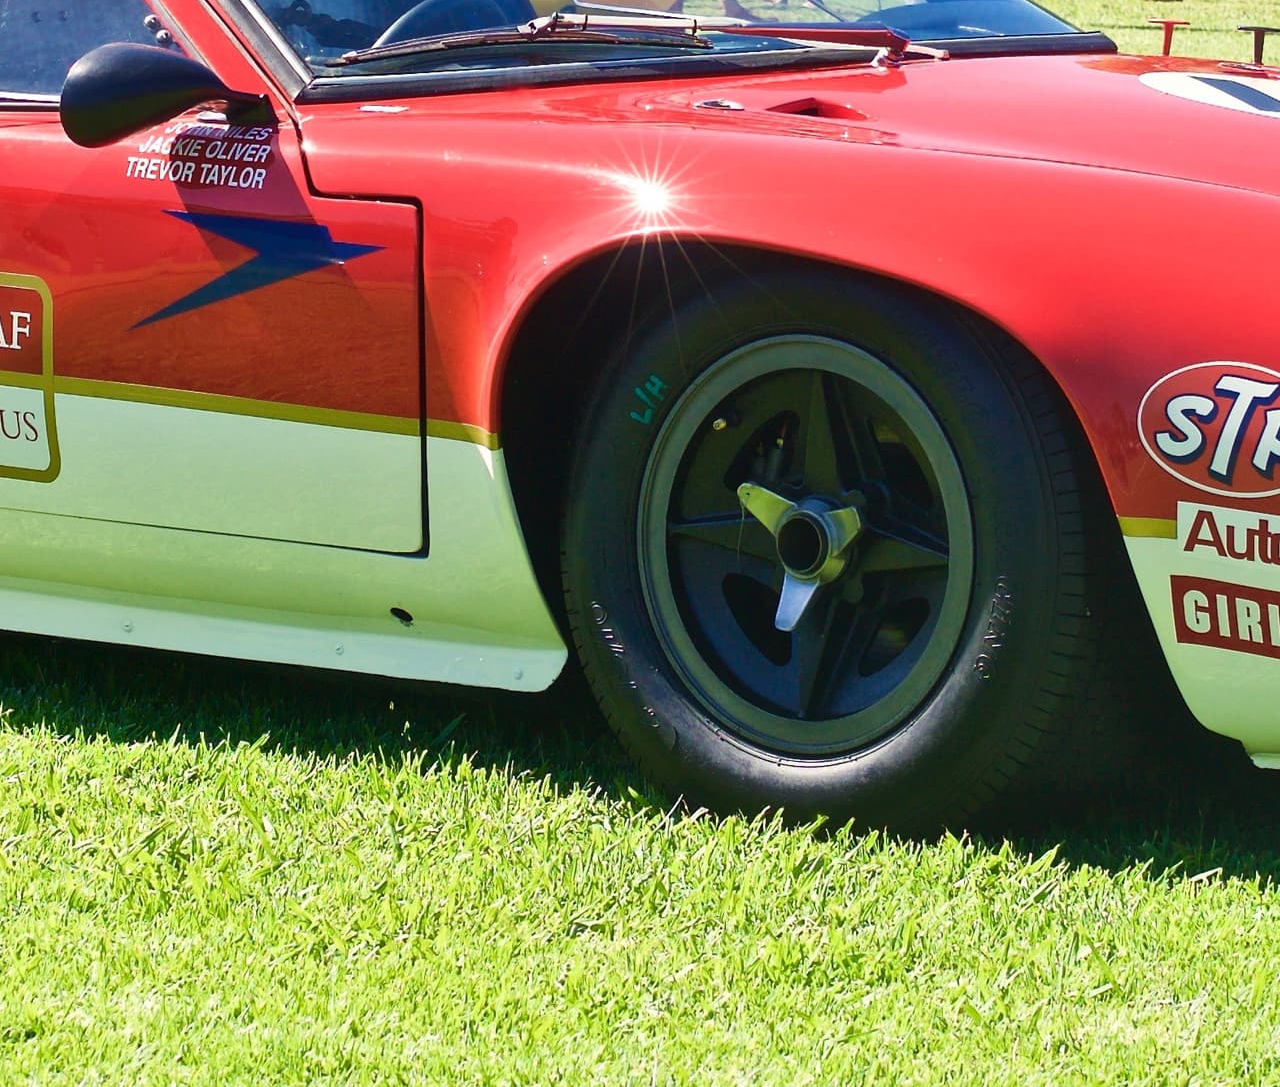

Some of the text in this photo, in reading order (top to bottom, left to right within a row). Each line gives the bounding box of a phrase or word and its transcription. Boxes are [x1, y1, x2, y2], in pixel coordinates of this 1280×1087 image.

[139, 136, 271, 163] JACKIE OLIVER
[126, 156, 266, 189] TREVOR TAYLOR
